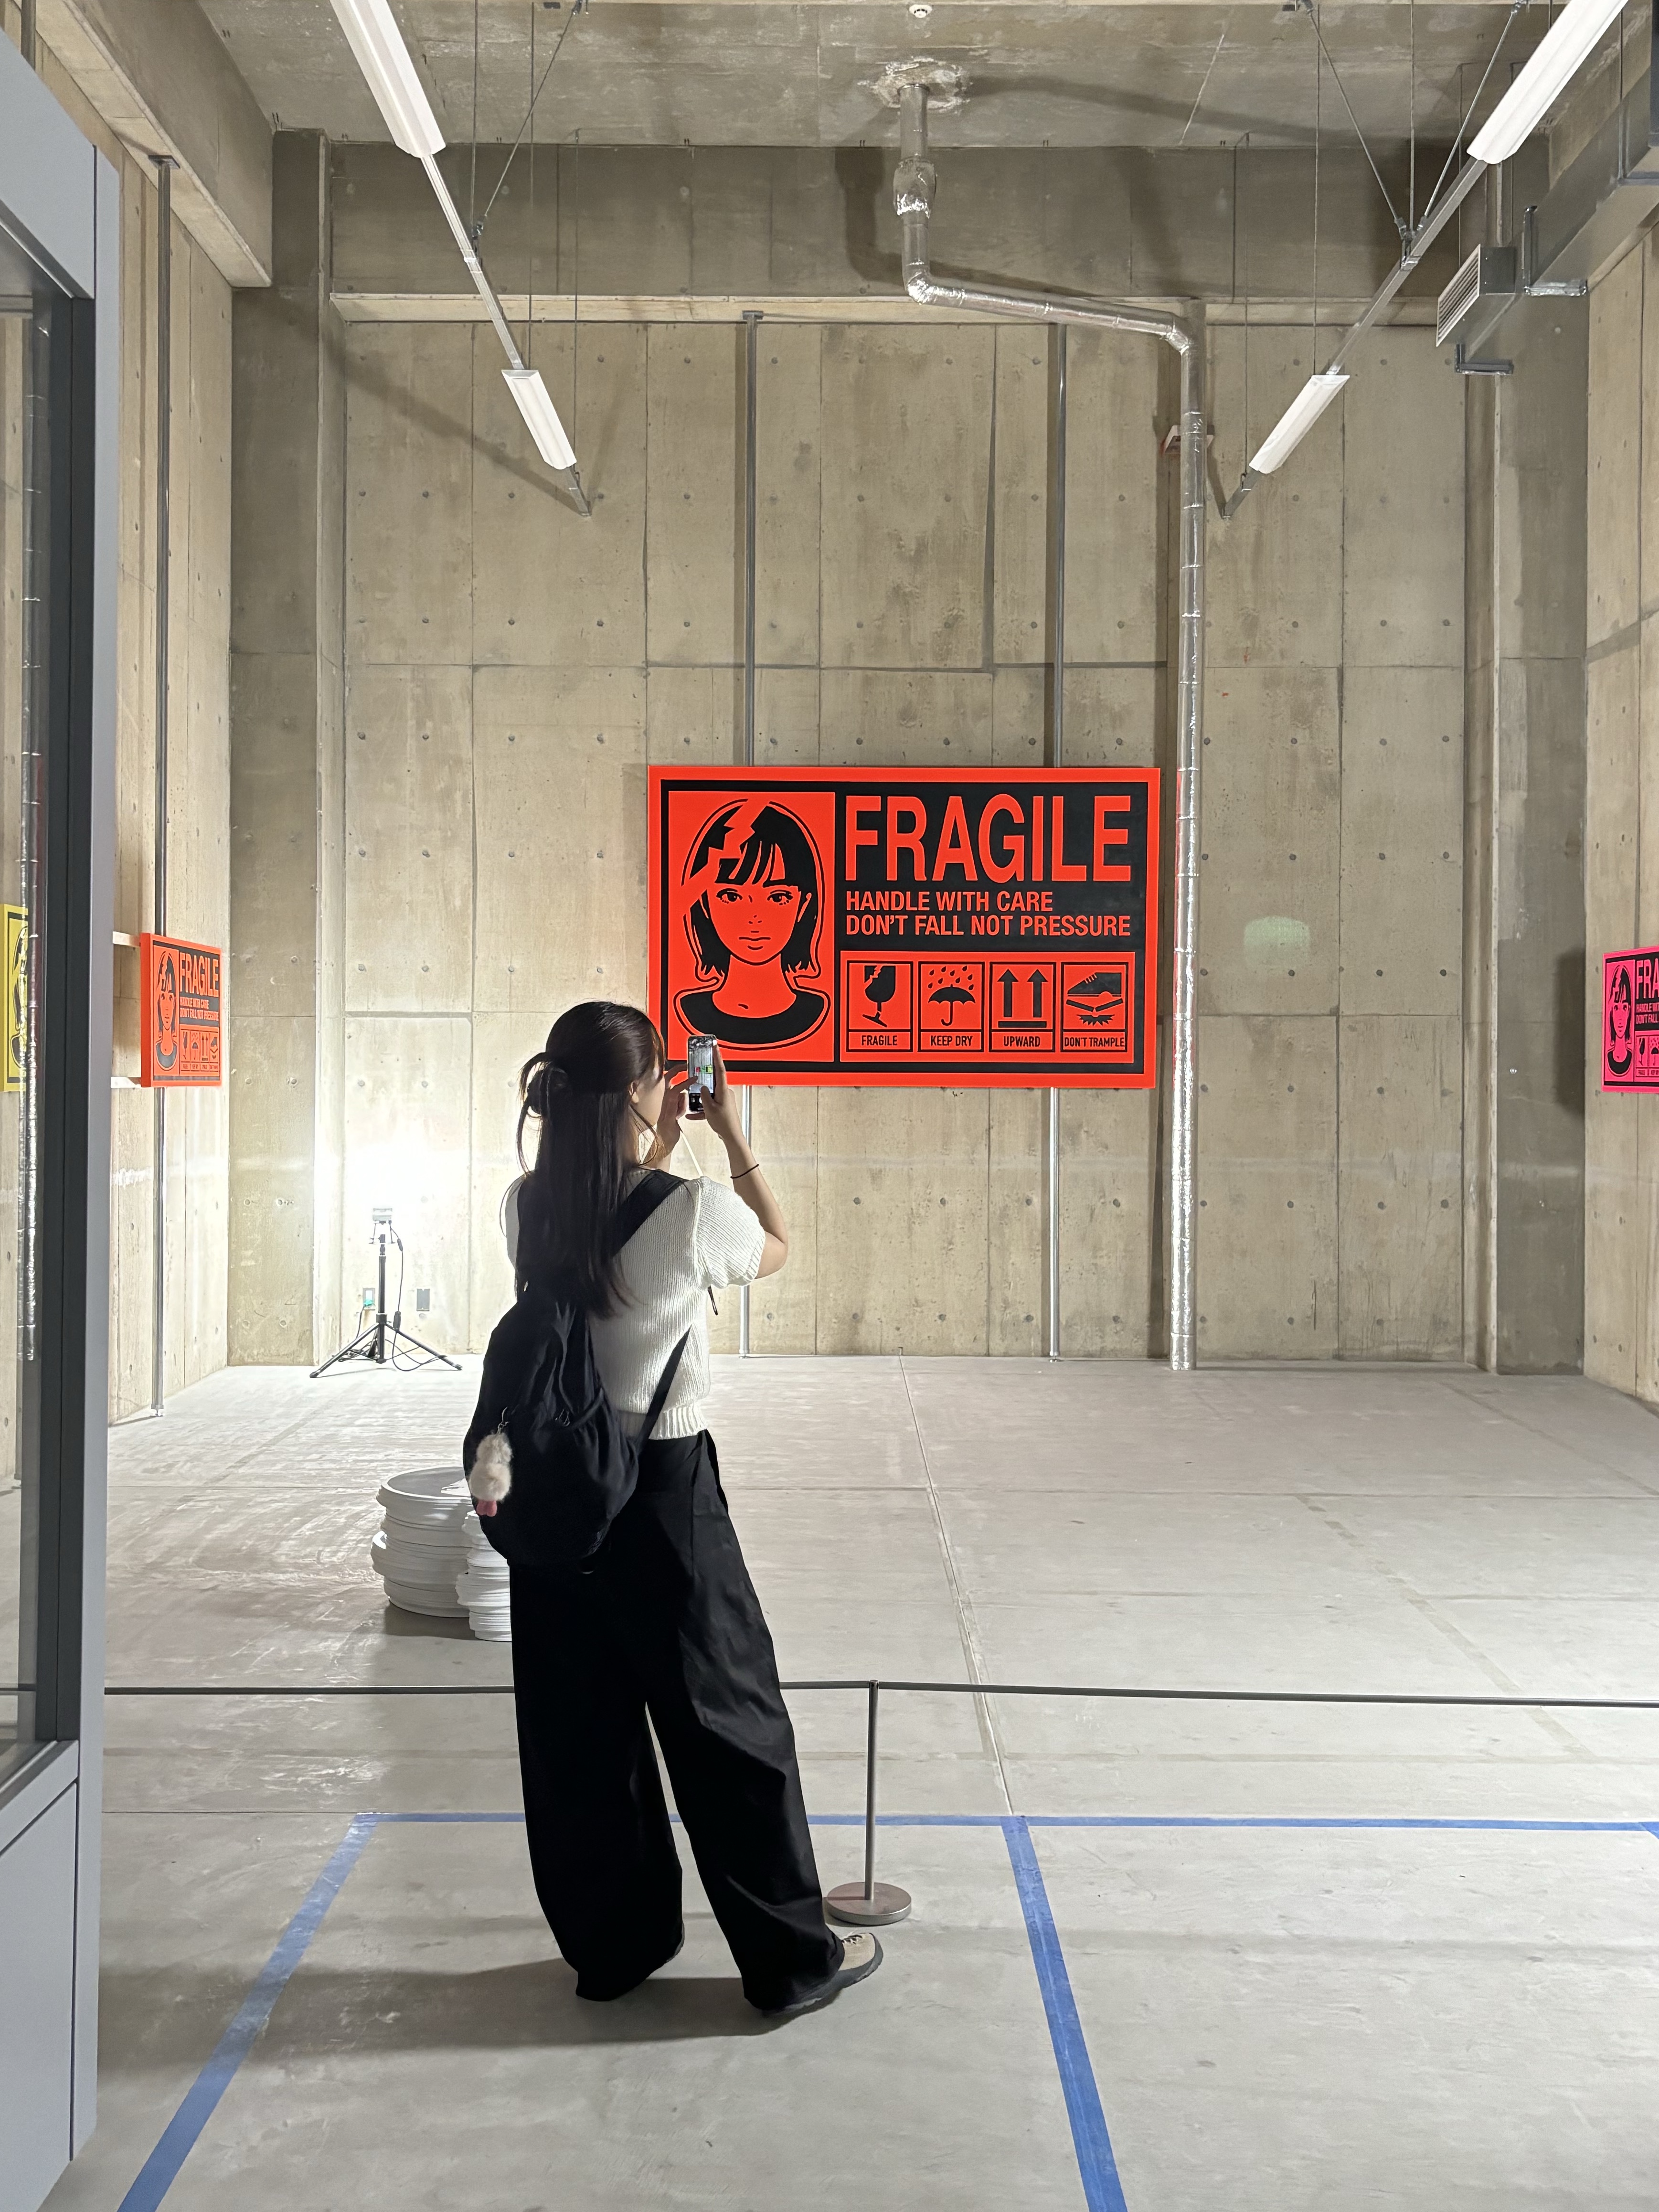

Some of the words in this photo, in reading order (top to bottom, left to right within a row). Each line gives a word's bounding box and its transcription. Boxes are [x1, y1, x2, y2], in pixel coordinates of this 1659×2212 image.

[845, 794, 1131, 883] FRAGILE
[846, 891, 930, 911] HANDLE
[936, 891, 989, 911] WITH
[997, 891, 1053, 912] CARE
[846, 914, 908, 935] DON'T
[915, 915, 964, 936] FALL
[971, 915, 1013, 936] NOT
[1020, 915, 1130, 936] PRESSURE
[179, 952, 219, 998] FRAGILE
[861, 1035, 898, 1046] FRAGILE
[930, 1035, 953, 1046] KEEP
[955, 1035, 973, 1047] DRY
[1003, 1036, 1041, 1047] UPWARD
[1064, 1037, 1088, 1047] DON'T
[1088, 1037, 1125, 1047] TRAMPLE
